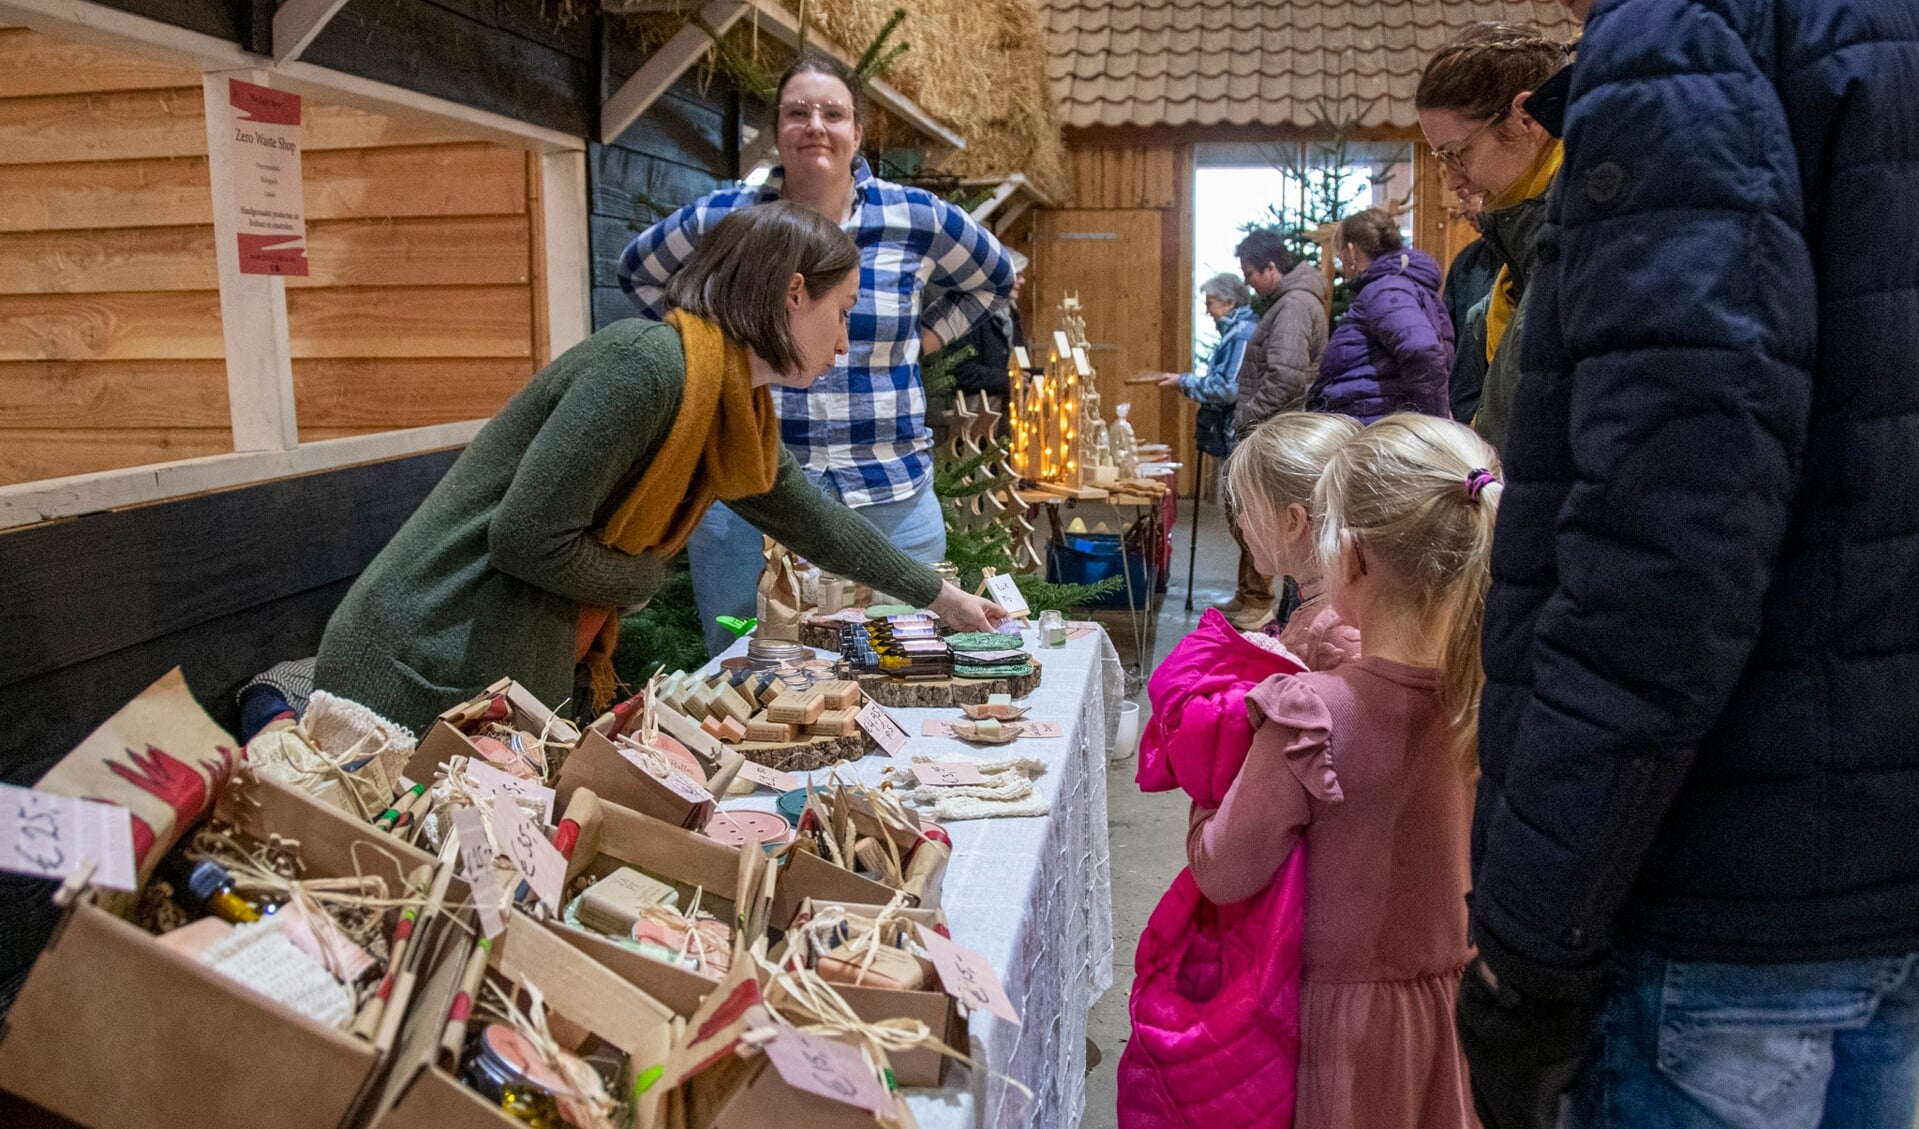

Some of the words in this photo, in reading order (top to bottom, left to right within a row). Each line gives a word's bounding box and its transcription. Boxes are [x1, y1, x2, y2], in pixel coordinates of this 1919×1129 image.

[235, 127, 254, 144] Zero
[255, 131, 277, 149] Waste
[278, 136, 296, 156] Shop
